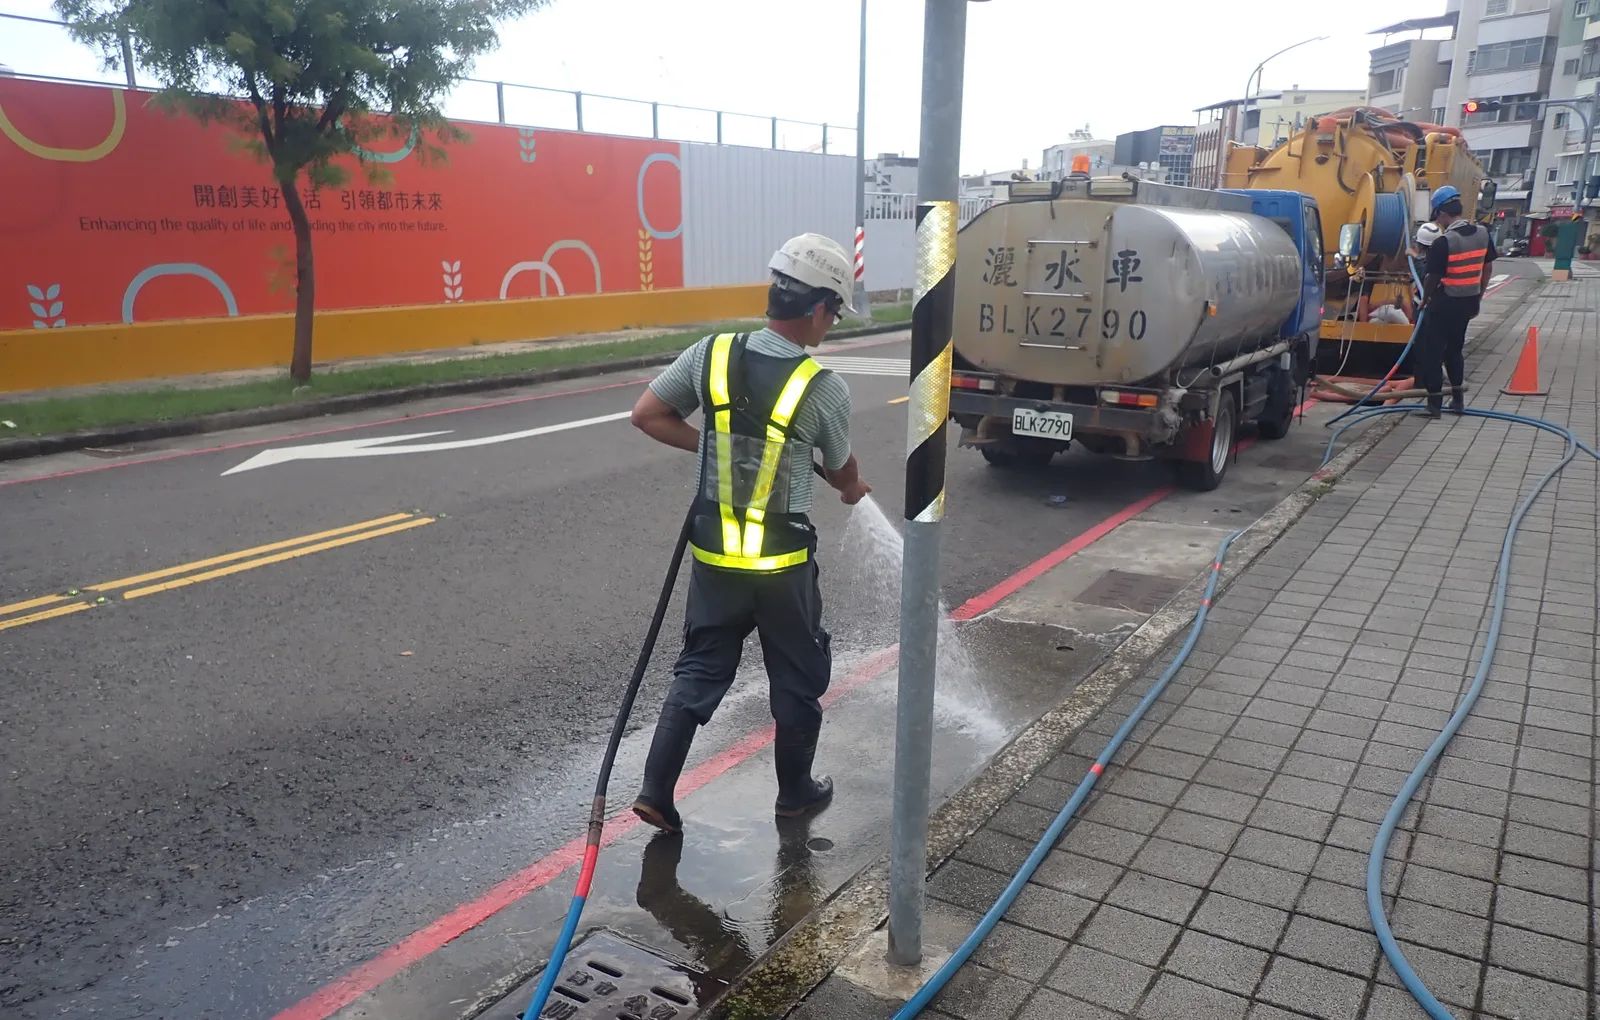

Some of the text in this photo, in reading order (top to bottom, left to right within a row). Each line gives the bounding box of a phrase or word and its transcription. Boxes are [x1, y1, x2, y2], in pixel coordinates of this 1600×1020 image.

[193, 184, 444, 211] 開創美好活 引領都市未來
[79, 216, 157, 234] Enhancing
[160, 217, 182, 231] the
[186, 218, 228, 234] quality
[232, 219, 245, 231] of
[248, 218, 266, 231] life
[270, 219, 292, 231] and
[339, 219, 355, 232] the
[358, 219, 376, 234] city
[378, 219, 398, 232] into
[400, 220, 415, 232] the
[982, 247, 1144, 293] 灑水車
[979, 303, 1147, 341] BLK2790
